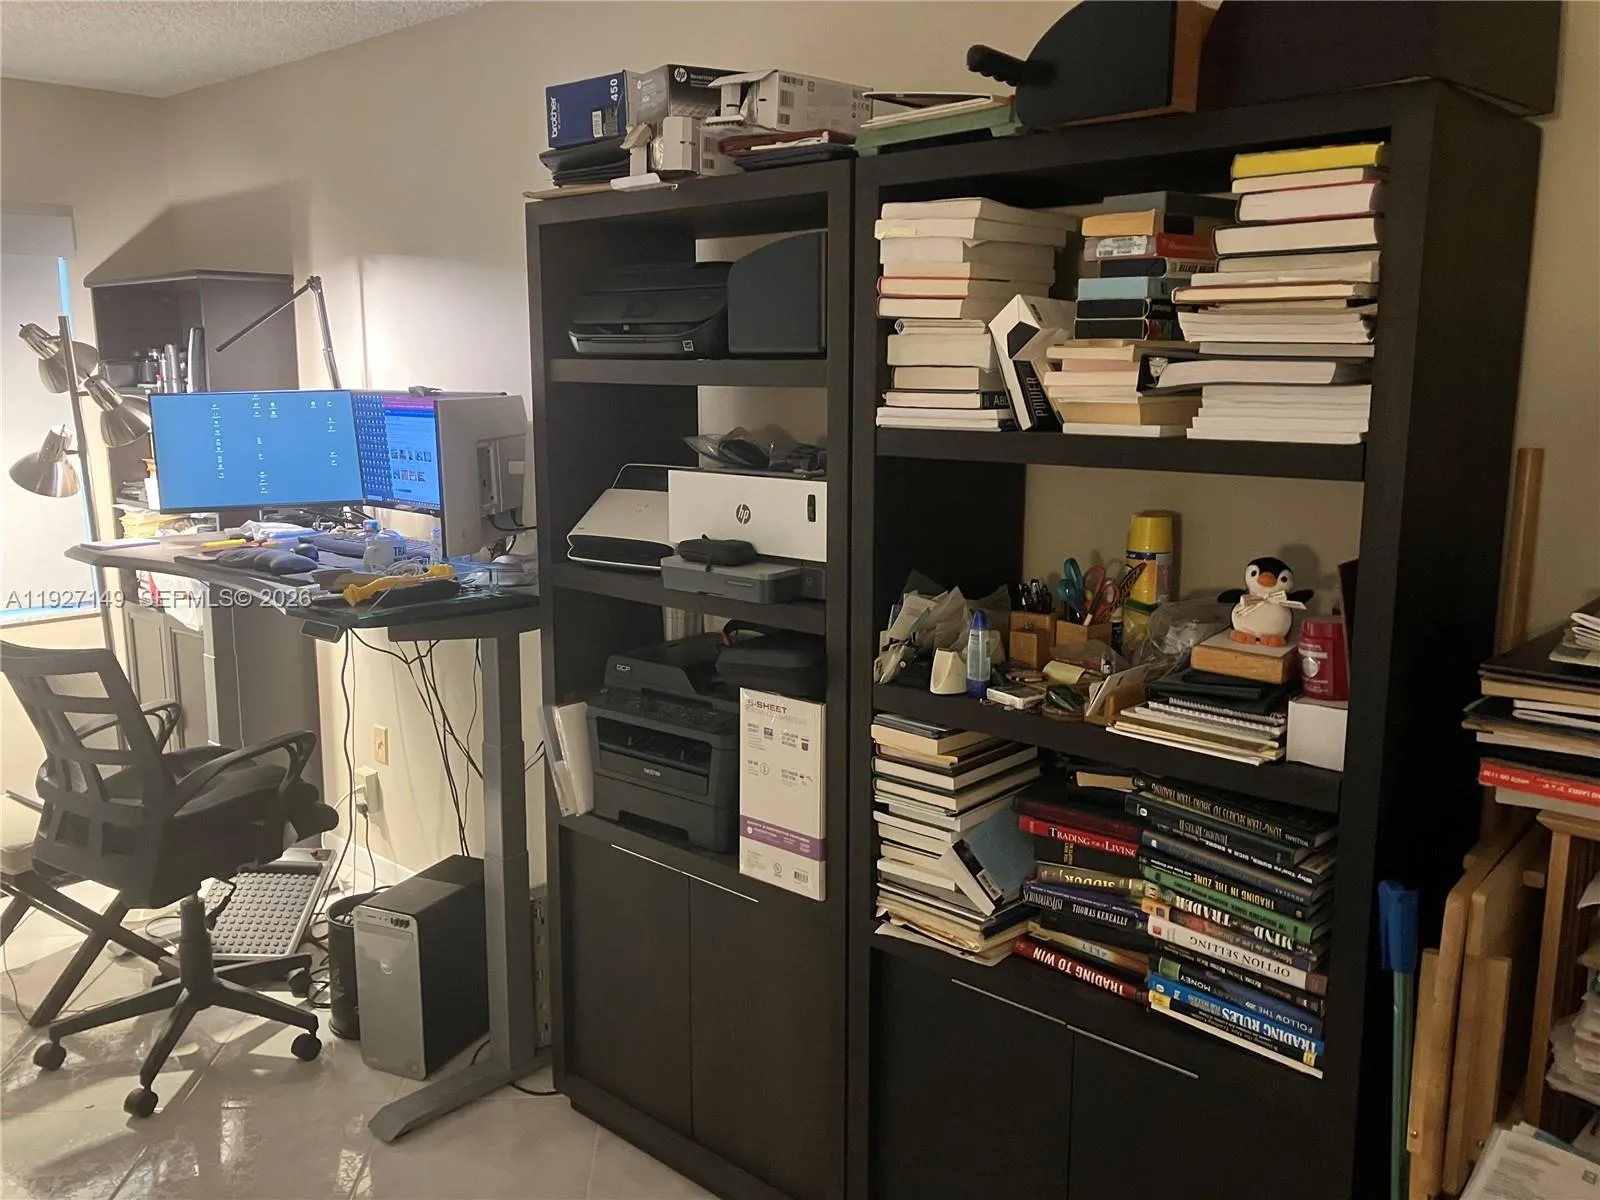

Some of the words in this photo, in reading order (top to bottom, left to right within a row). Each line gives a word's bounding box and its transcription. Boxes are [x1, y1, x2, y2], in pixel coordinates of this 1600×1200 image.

[610, 78, 618, 102] 450
[1026, 377, 1048, 416] POWER
[1049, 827, 1090, 845] TRADING
[1193, 874, 1212, 888] ZONE
[1214, 880, 1228, 894] THE
[1230, 886, 1239, 897] IN
[1242, 890, 1275, 910] TRADING
[1072, 904, 1096, 918] THOMAS
[1097, 908, 1128, 926] KENEALLY
[1176, 896, 1231, 928] TRADER
[1190, 936, 1238, 960] SELLING
[1254, 925, 1294, 950] MIND
[1032, 946, 1056, 966] WIN
[1058, 958, 1072, 974] TO
[1243, 954, 1290, 978] OPTION
[1076, 966, 1125, 996] TRADING
[1180, 975, 1211, 992] MONEY
[1222, 1007, 1260, 1032] RULES
[1260, 1006, 1274, 1018] THE
[1276, 1014, 1313, 1034] FOLLOW
[1263, 1023, 1316, 1053] TRADING
